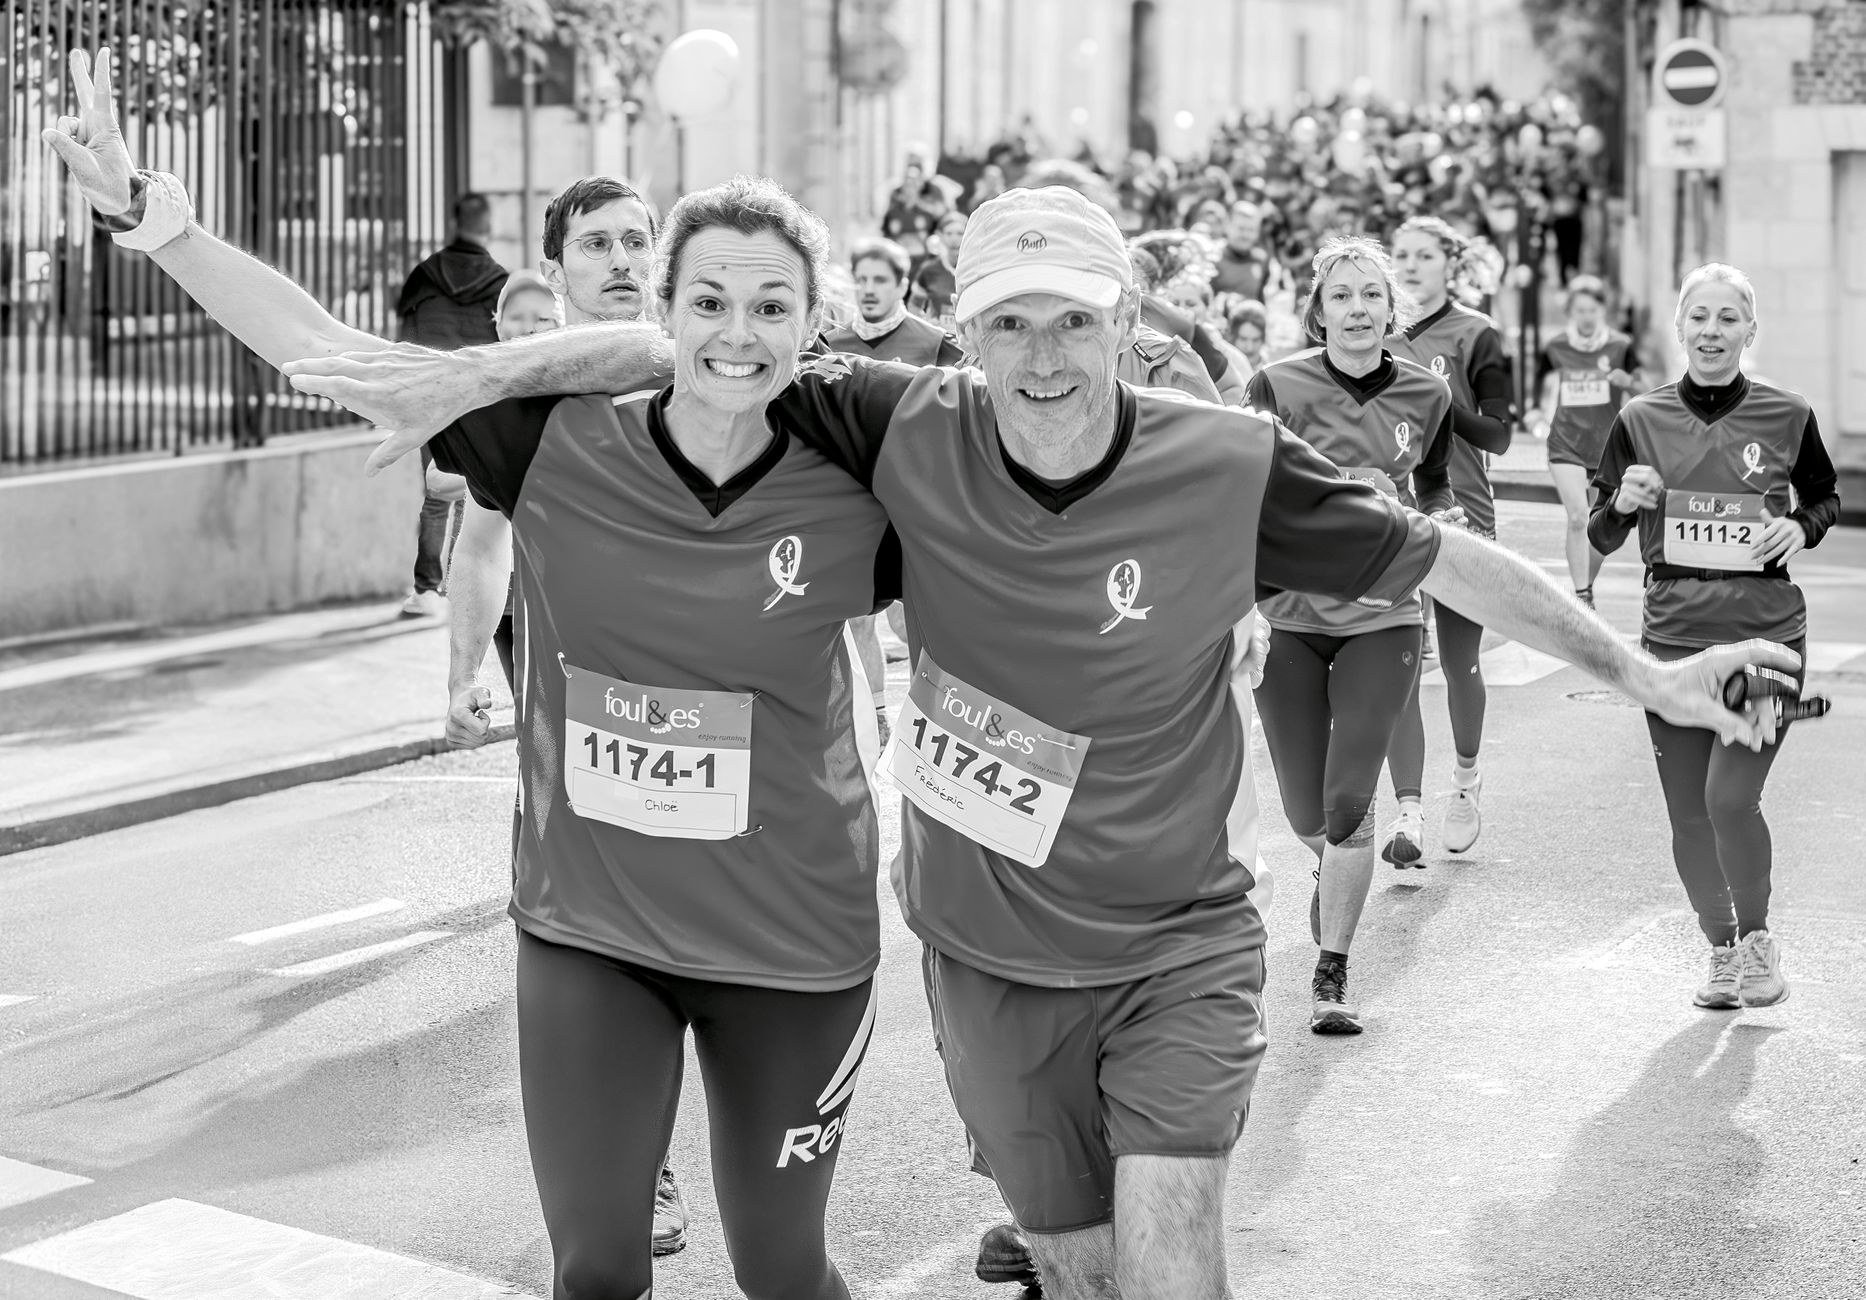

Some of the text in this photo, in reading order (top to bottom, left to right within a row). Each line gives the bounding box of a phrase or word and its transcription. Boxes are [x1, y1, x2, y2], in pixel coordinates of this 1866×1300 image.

[1688, 496, 1742, 515] foul&es
[1675, 522, 1752, 545] 1111-2
[604, 687, 701, 731] foul&es
[942, 687, 1037, 755] foul&es
[584, 732, 716, 789] 1174-1
[912, 716, 1042, 816] 1174-2
